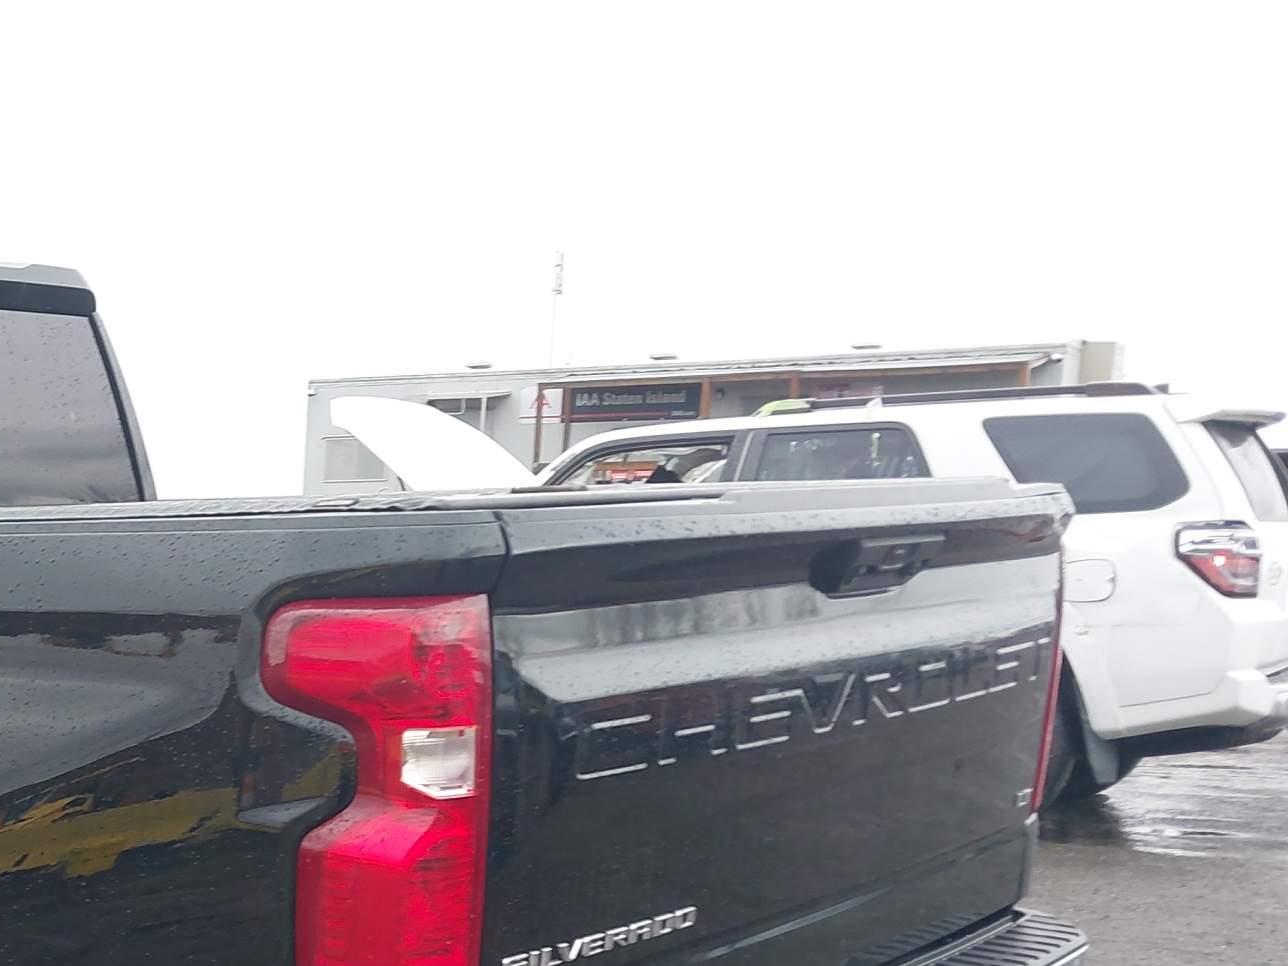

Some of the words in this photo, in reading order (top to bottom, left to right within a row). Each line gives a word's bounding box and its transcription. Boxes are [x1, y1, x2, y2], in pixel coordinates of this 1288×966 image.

[575, 392, 600, 407] IAA
[602, 391, 643, 405] Staten
[645, 389, 686, 403] Island
[575, 636, 1051, 780] CHEVROLET
